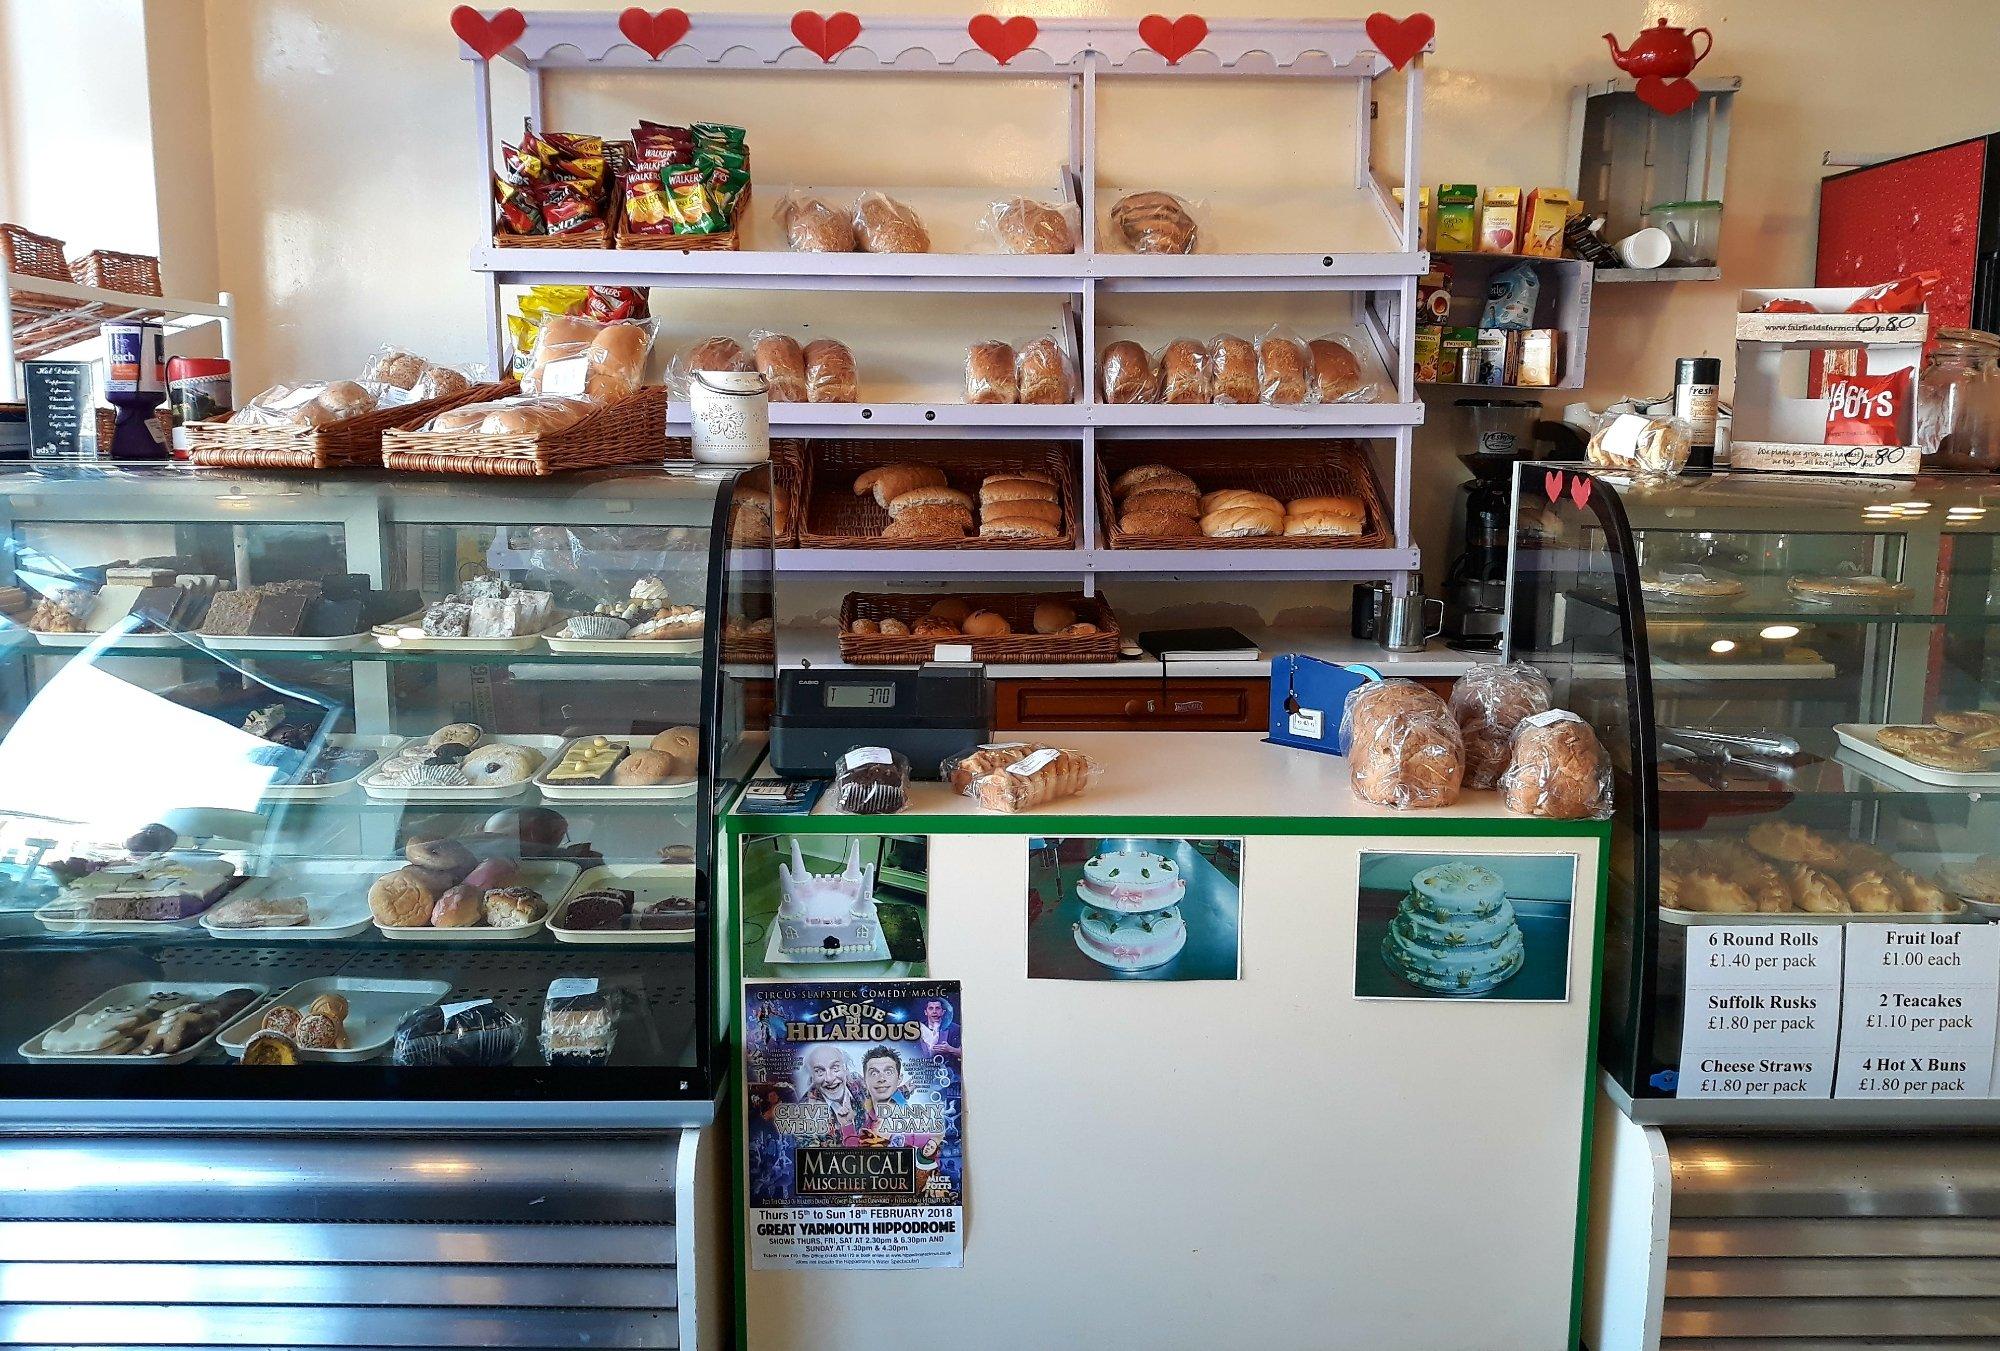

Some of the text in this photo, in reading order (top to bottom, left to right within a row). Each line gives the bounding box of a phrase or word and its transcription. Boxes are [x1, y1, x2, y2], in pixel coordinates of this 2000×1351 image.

[668, 172, 704, 185] WALKERS
[1709, 932, 1819, 946] 6 Round Rolls
[1886, 931, 1961, 945] Fruit loaf
[1710, 953, 1816, 970] £1.40 per pack
[1883, 952, 1961, 966] £1.00 each
[757, 988, 947, 999] CIRCUS SLAPSTICK COMEDY MAGIC
[1879, 993, 1962, 1007] 2 Teacakes
[1708, 995, 1817, 1009] Suffolk Rusks
[819, 1003, 886, 1023] CIRQUE
[1708, 1016, 1815, 1033] £1.80 per pack
[1866, 1014, 1973, 1031] £1.10 per pack
[786, 1020, 921, 1042] HILARIOUS
[1701, 1060, 1812, 1073] Cheese Straws
[1862, 1058, 1967, 1071] 4 Hot X Buns
[1700, 1079, 1808, 1095] £1.80 per pack
[1859, 1078, 1965, 1094] £1.80 per pack
[774, 1103, 829, 1119] CLIVE
[877, 1103, 945, 1119] DANNY
[776, 1119, 829, 1134] WEBB
[879, 1118, 944, 1134] ADAMS
[803, 1151, 909, 1175] MAGICAL
[803, 1175, 909, 1190] MISCHIEF TOUR
[759, 1208, 953, 1220] Thurs 15th to Sun 18th FEBRUARY 2018
[757, 1221, 956, 1236] GREAT YARMOUTH HIPPODROME
[866, 1236, 891, 1244] 2.30pm
